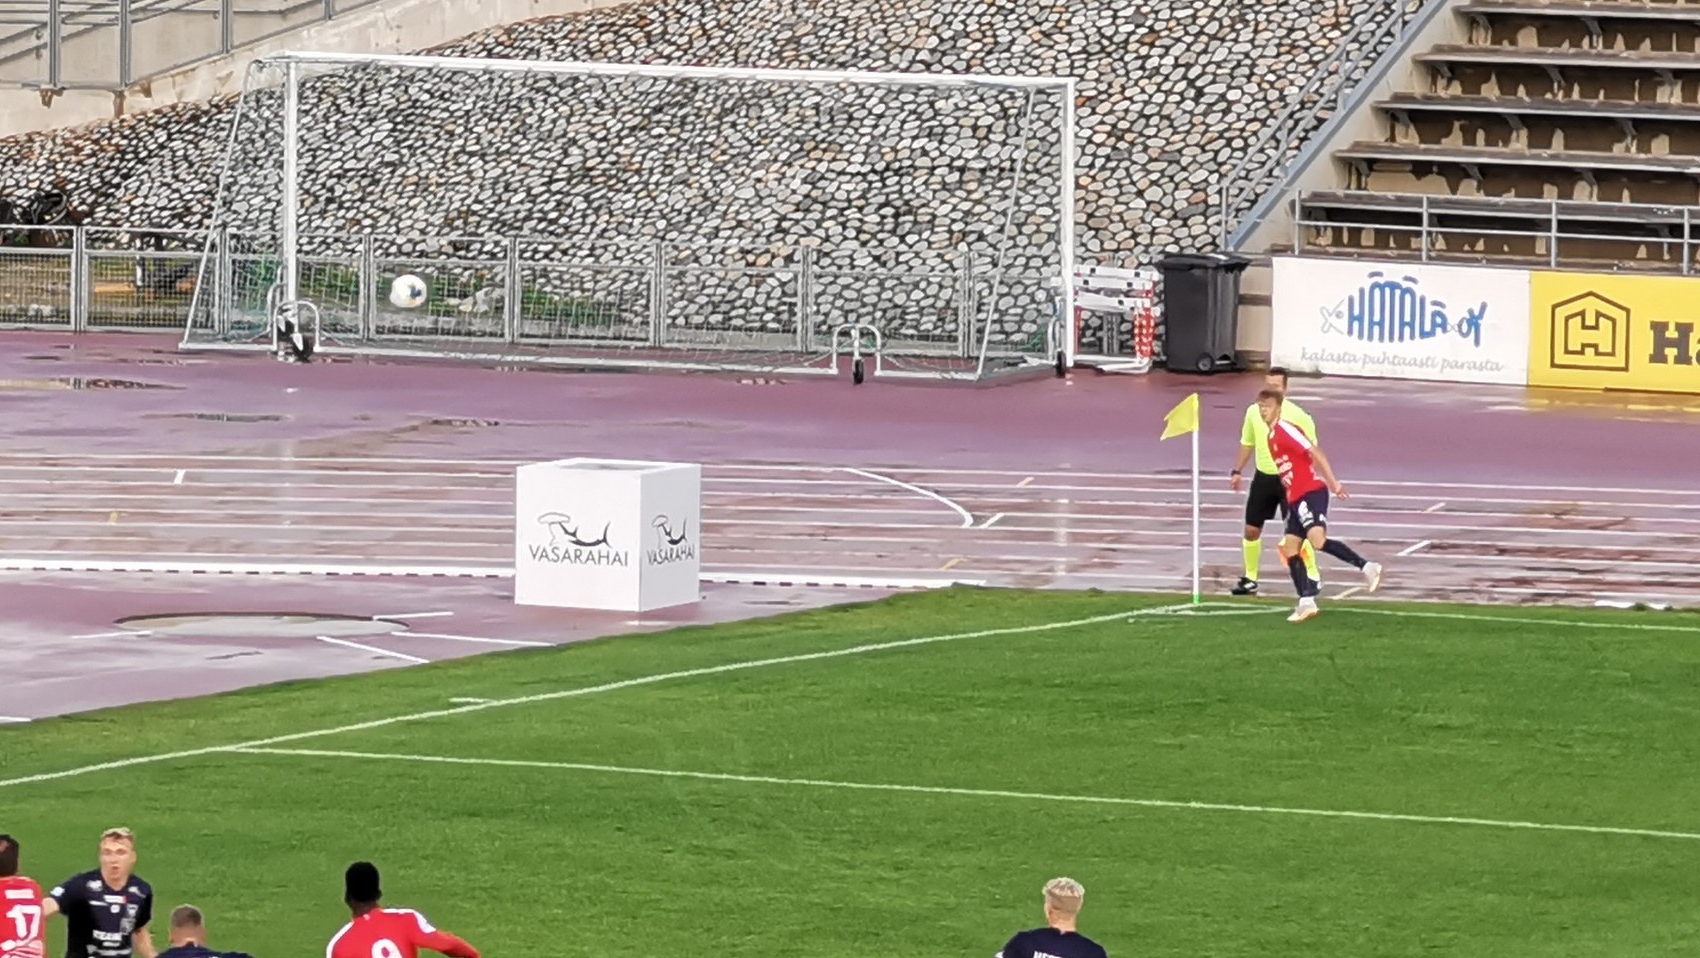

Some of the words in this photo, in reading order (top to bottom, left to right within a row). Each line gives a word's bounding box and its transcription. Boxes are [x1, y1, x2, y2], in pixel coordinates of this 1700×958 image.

[1300, 347, 1360, 365] kalasta
[1361, 350, 1439, 371] puhtaasti
[1441, 354, 1504, 373] parasta
[529, 544, 628, 567] VASARAHAI
[647, 544, 696, 566] VASARAHAI
[6, 904, 42, 940] 17
